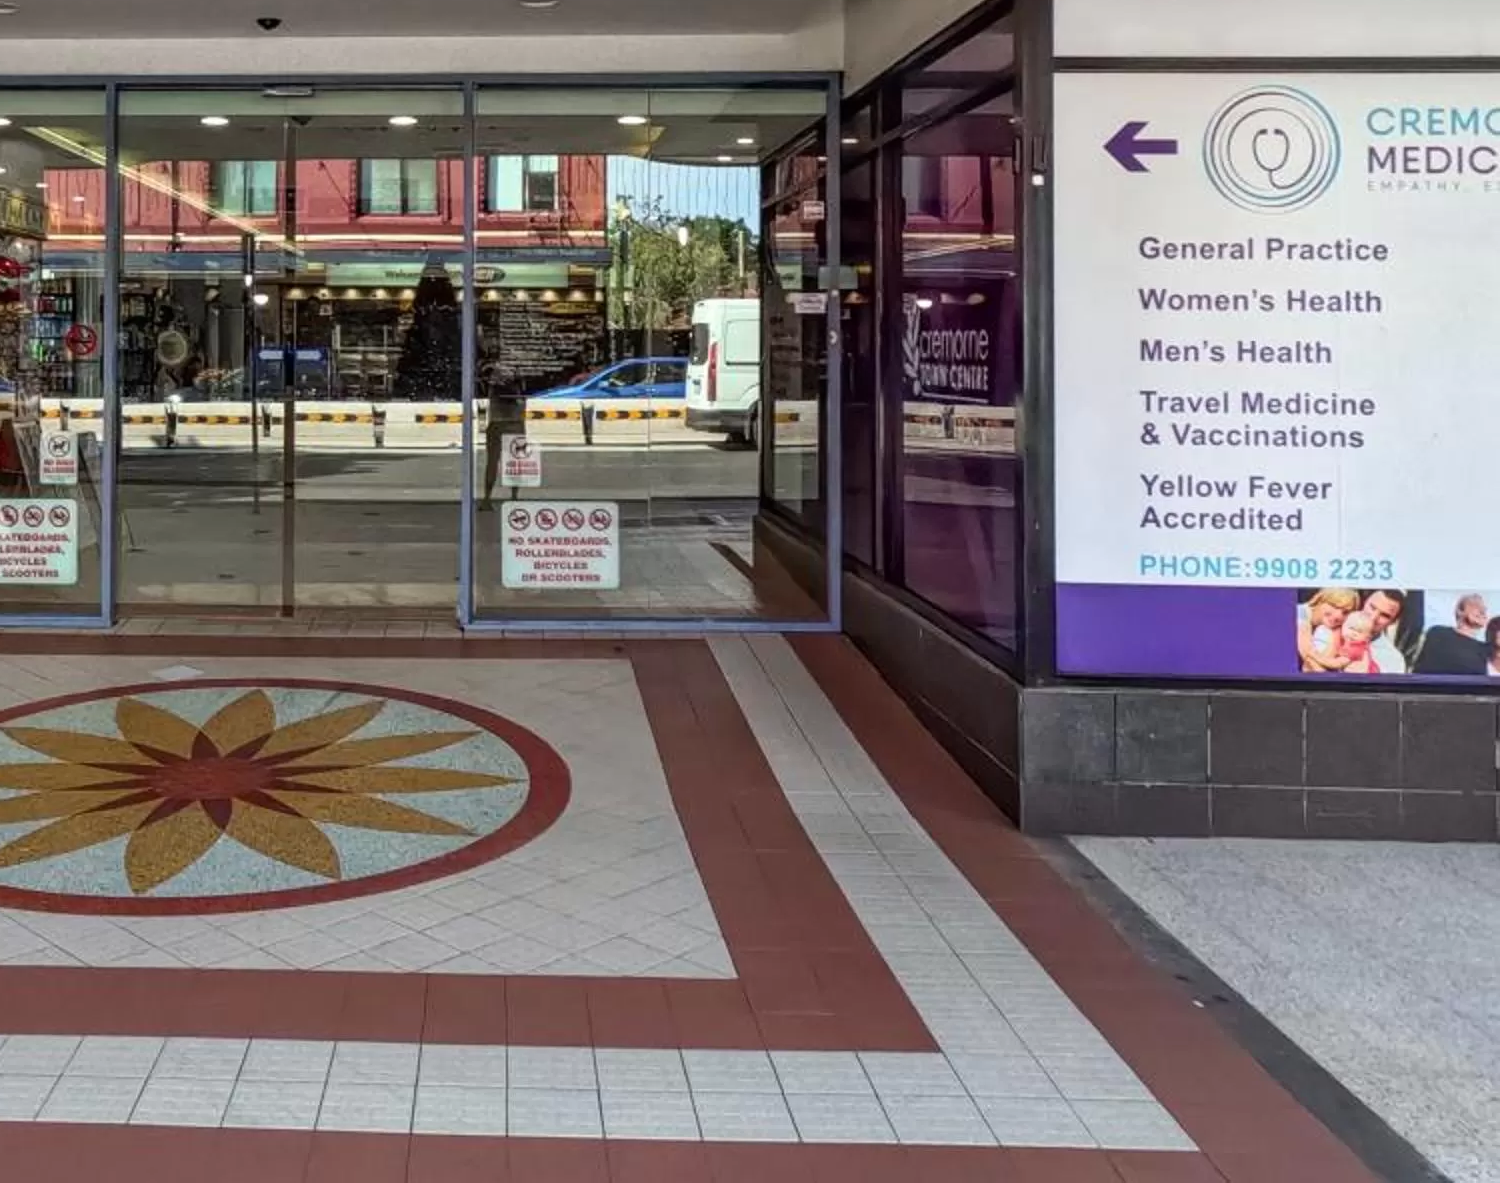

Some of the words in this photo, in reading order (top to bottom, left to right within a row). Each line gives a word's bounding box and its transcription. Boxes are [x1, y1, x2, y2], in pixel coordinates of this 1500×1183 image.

[1368, 146, 1497, 174] MEDIC
[1138, 237, 1254, 262] General
[1265, 237, 1388, 263] Practice
[1138, 288, 1275, 313] Women's
[1287, 289, 1382, 313] Health
[919, 328, 989, 361] cremorne
[1139, 340, 1225, 364] Men's
[1237, 340, 1332, 365] Health
[950, 365, 989, 391] CENTRE
[1140, 391, 1229, 415] Travel
[1241, 391, 1376, 417] Medicine
[1140, 423, 1161, 447] &
[1171, 422, 1365, 449] Vaccinations
[1140, 474, 1237, 499] Yellow
[1249, 476, 1332, 500] Fever
[1139, 505, 1303, 532] Accredited
[1329, 560, 1394, 581] 2233
